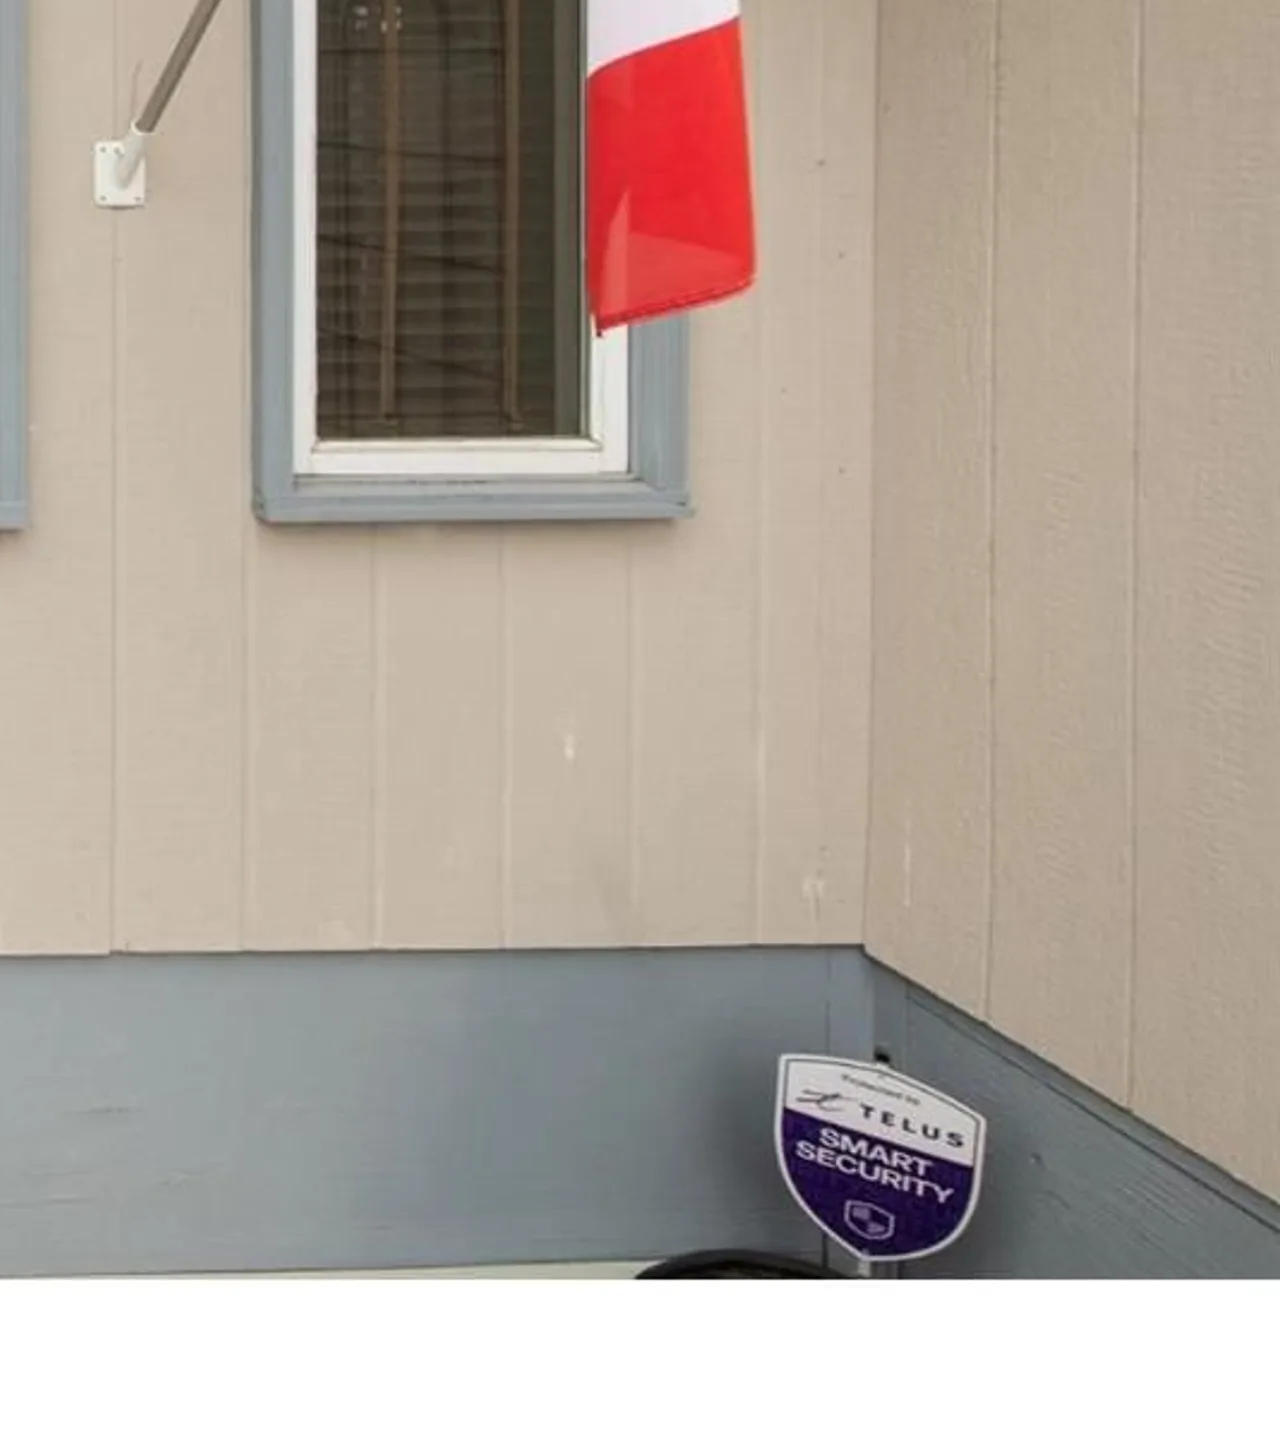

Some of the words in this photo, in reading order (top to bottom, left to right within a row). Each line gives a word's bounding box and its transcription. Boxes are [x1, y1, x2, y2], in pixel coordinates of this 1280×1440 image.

[860, 1103, 965, 1148] TELUS
[795, 1140, 954, 1204] SECURITY
[819, 1127, 934, 1177] SMART
